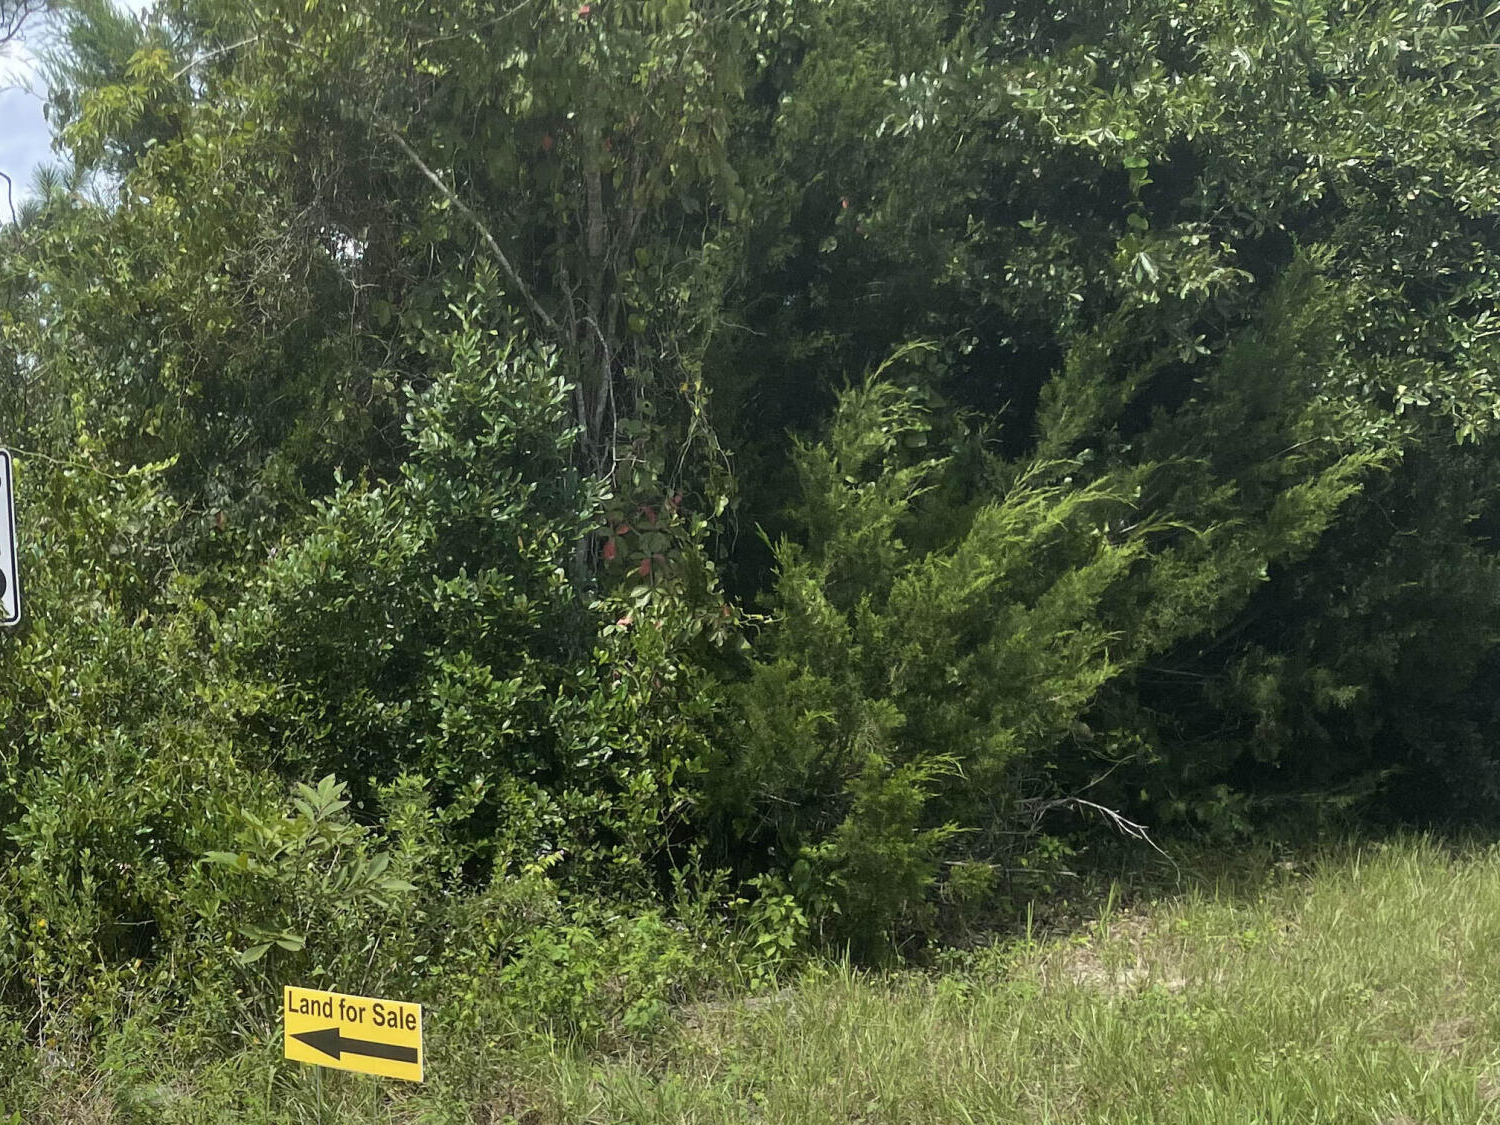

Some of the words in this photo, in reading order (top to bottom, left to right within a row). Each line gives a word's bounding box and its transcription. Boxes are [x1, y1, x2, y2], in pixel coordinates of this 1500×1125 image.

[288, 990, 333, 1018] Land
[339, 998, 366, 1023] for
[372, 1002, 417, 1031] Sale
